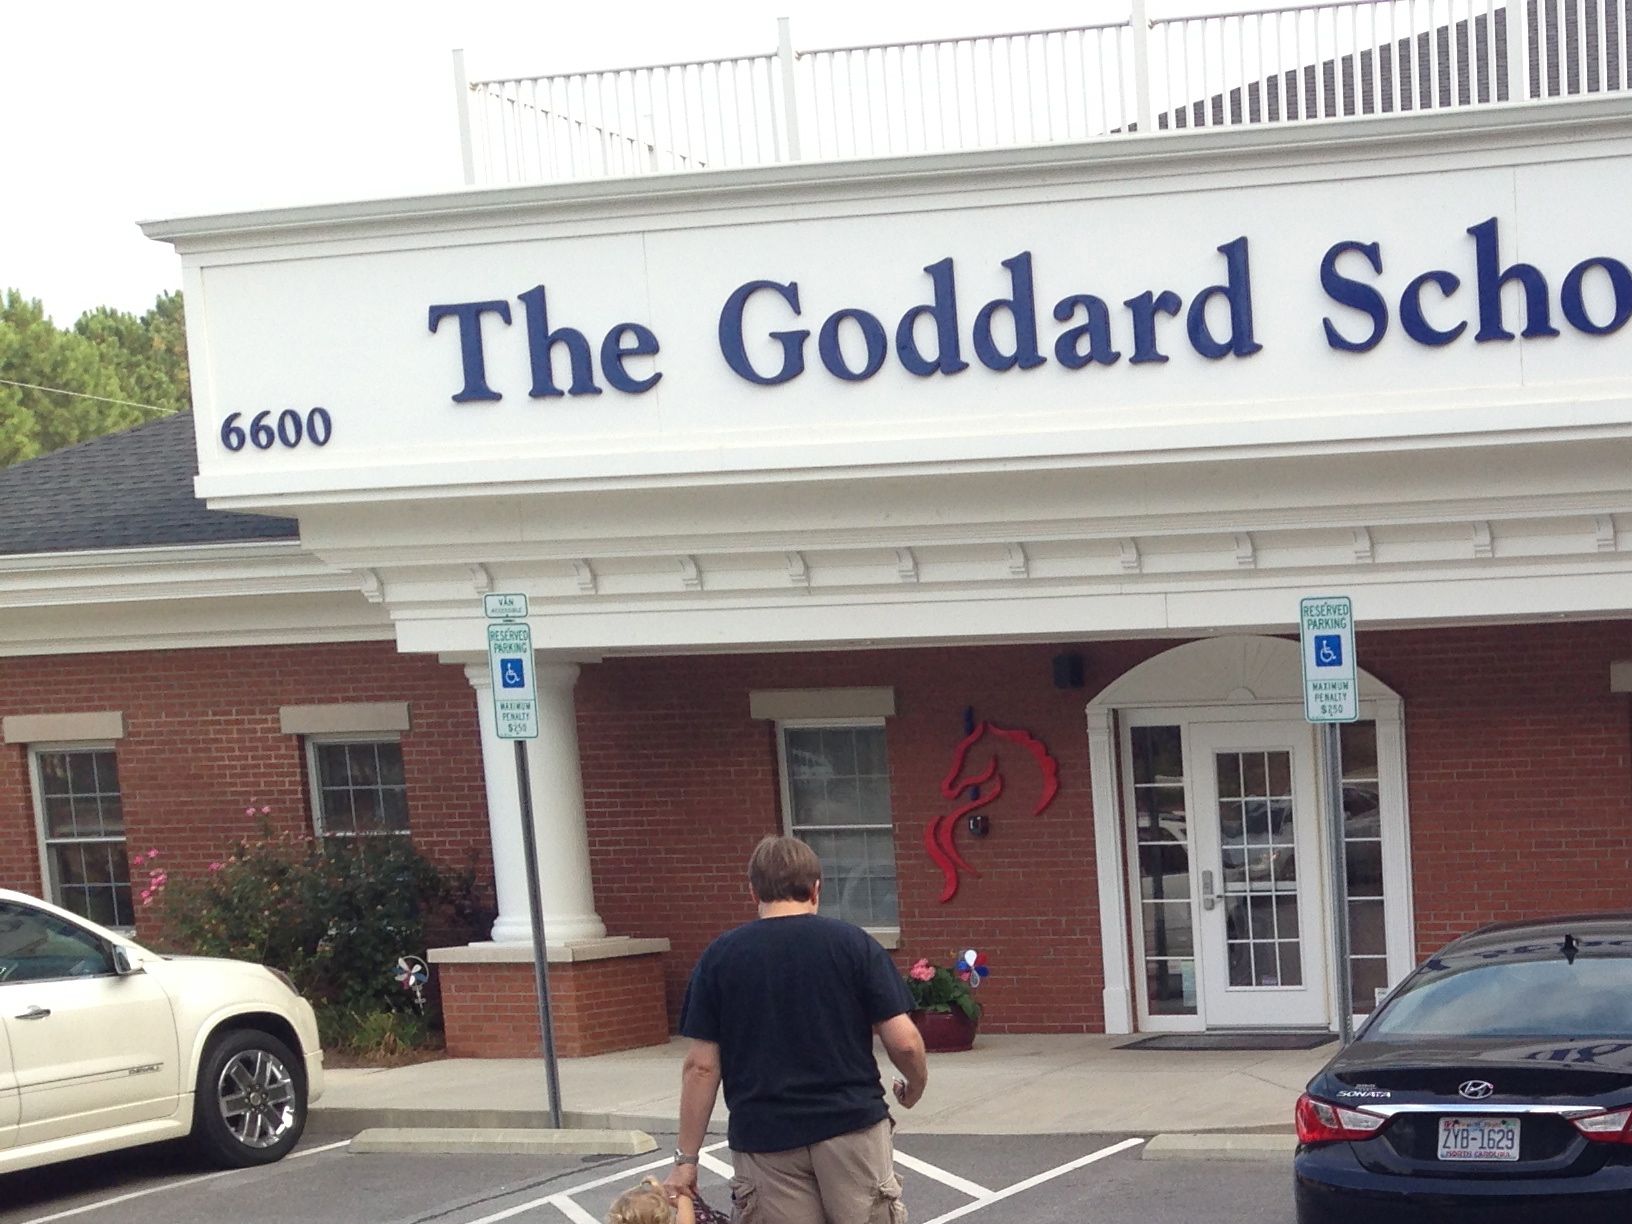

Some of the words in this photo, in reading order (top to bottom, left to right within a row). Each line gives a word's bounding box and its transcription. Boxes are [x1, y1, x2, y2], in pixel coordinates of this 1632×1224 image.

[428, 286, 661, 402] The
[717, 239, 1262, 387] Goddard
[220, 407, 333, 450] 6600
[1303, 604, 1349, 618] RESERVED
[1307, 618, 1347, 630] PARKING
[489, 630, 529, 641] RESERVED
[494, 642, 528, 653] PARKING
[1312, 681, 1349, 691] MAXIMUM
[1314, 692, 1347, 702] PENALTY
[500, 702, 531, 711] MAXIMUM
[1320, 704, 1343, 714] $250
[502, 712, 529, 721] PENALTY
[508, 723, 527, 732] $250
[1336, 1090, 1391, 1098] SONATA
[1442, 1128, 1515, 1150] ZYB-1629
